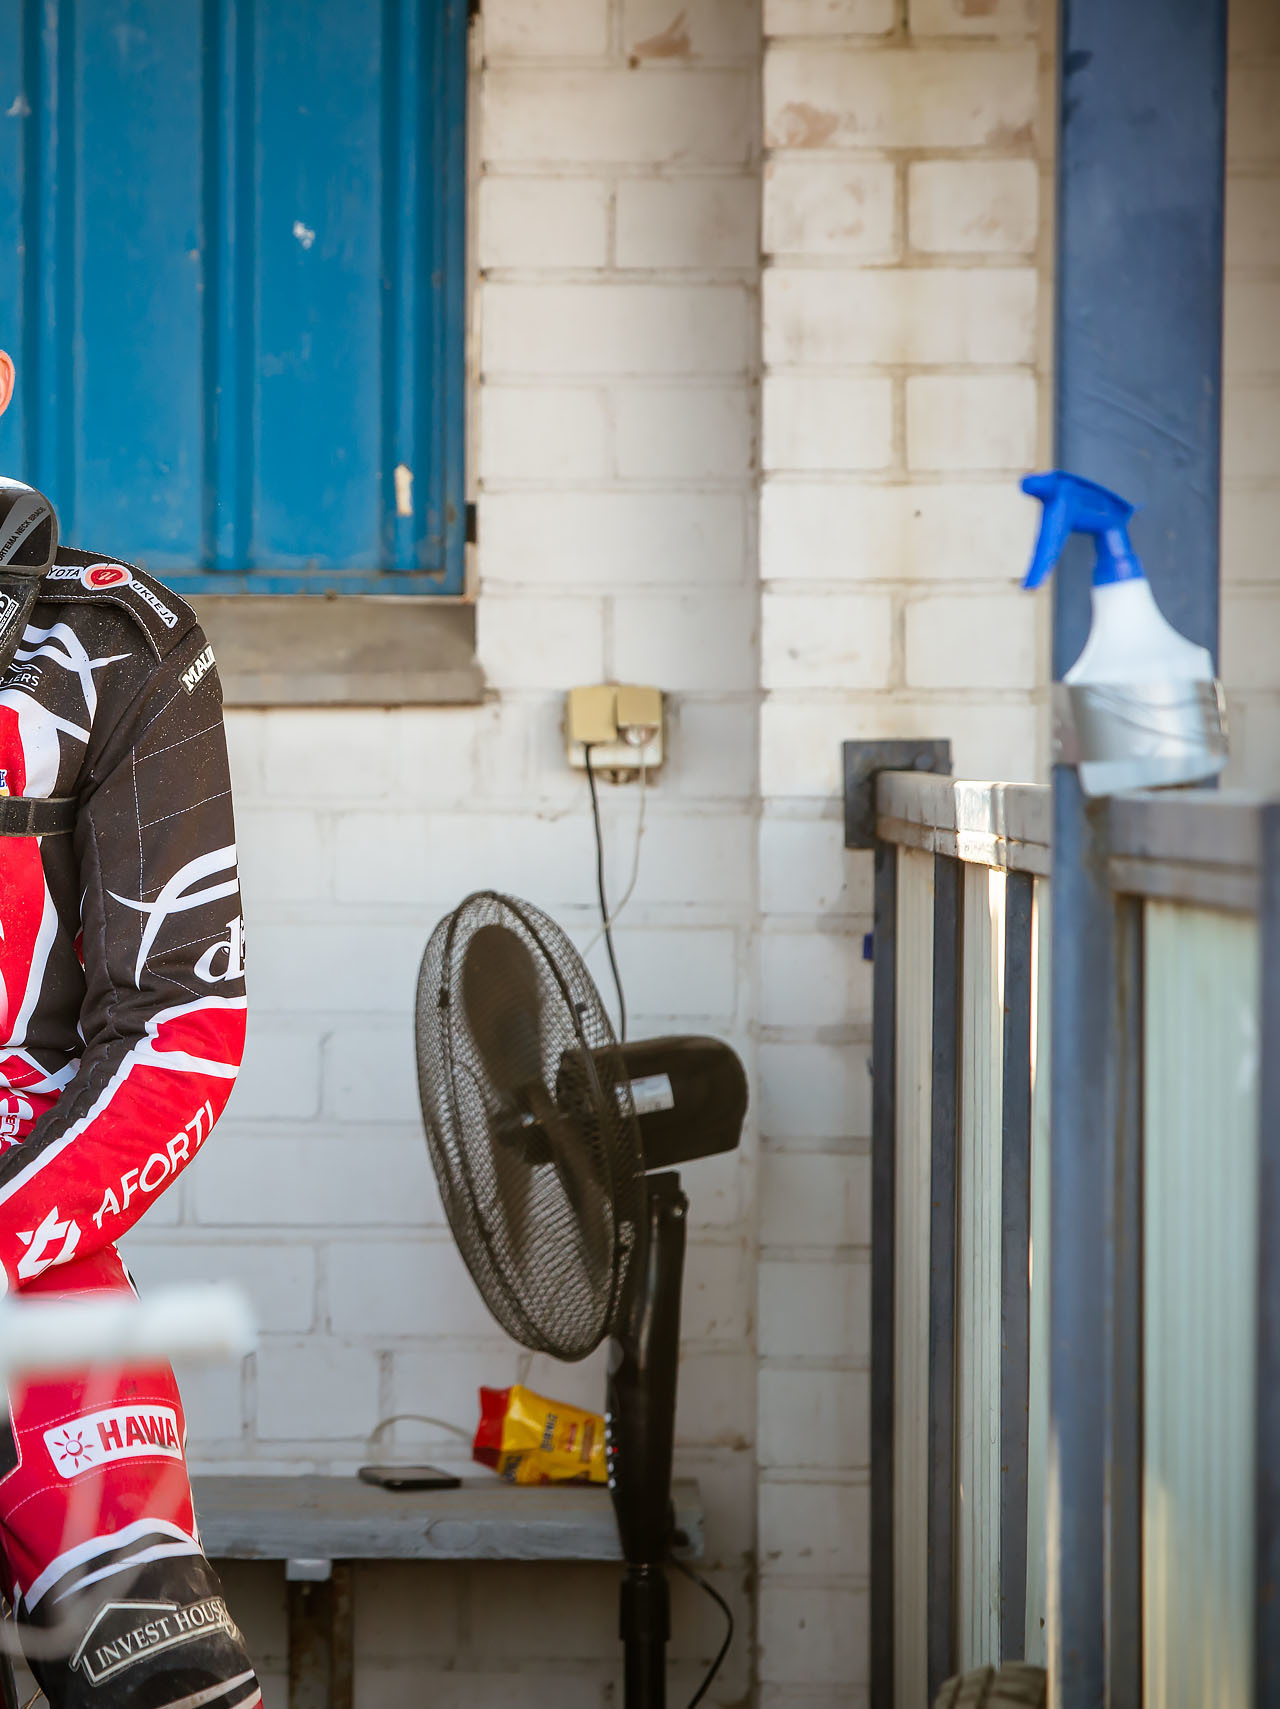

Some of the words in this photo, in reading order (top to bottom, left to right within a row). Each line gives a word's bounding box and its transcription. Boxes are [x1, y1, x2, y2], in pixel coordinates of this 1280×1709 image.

[14, 519, 32, 536] NECK
[132, 582, 174, 625] UKLEJA
[92, 1100, 214, 1230] AFORTI
[96, 1415, 180, 1453] HAWA
[96, 1616, 171, 1669] INVEST
